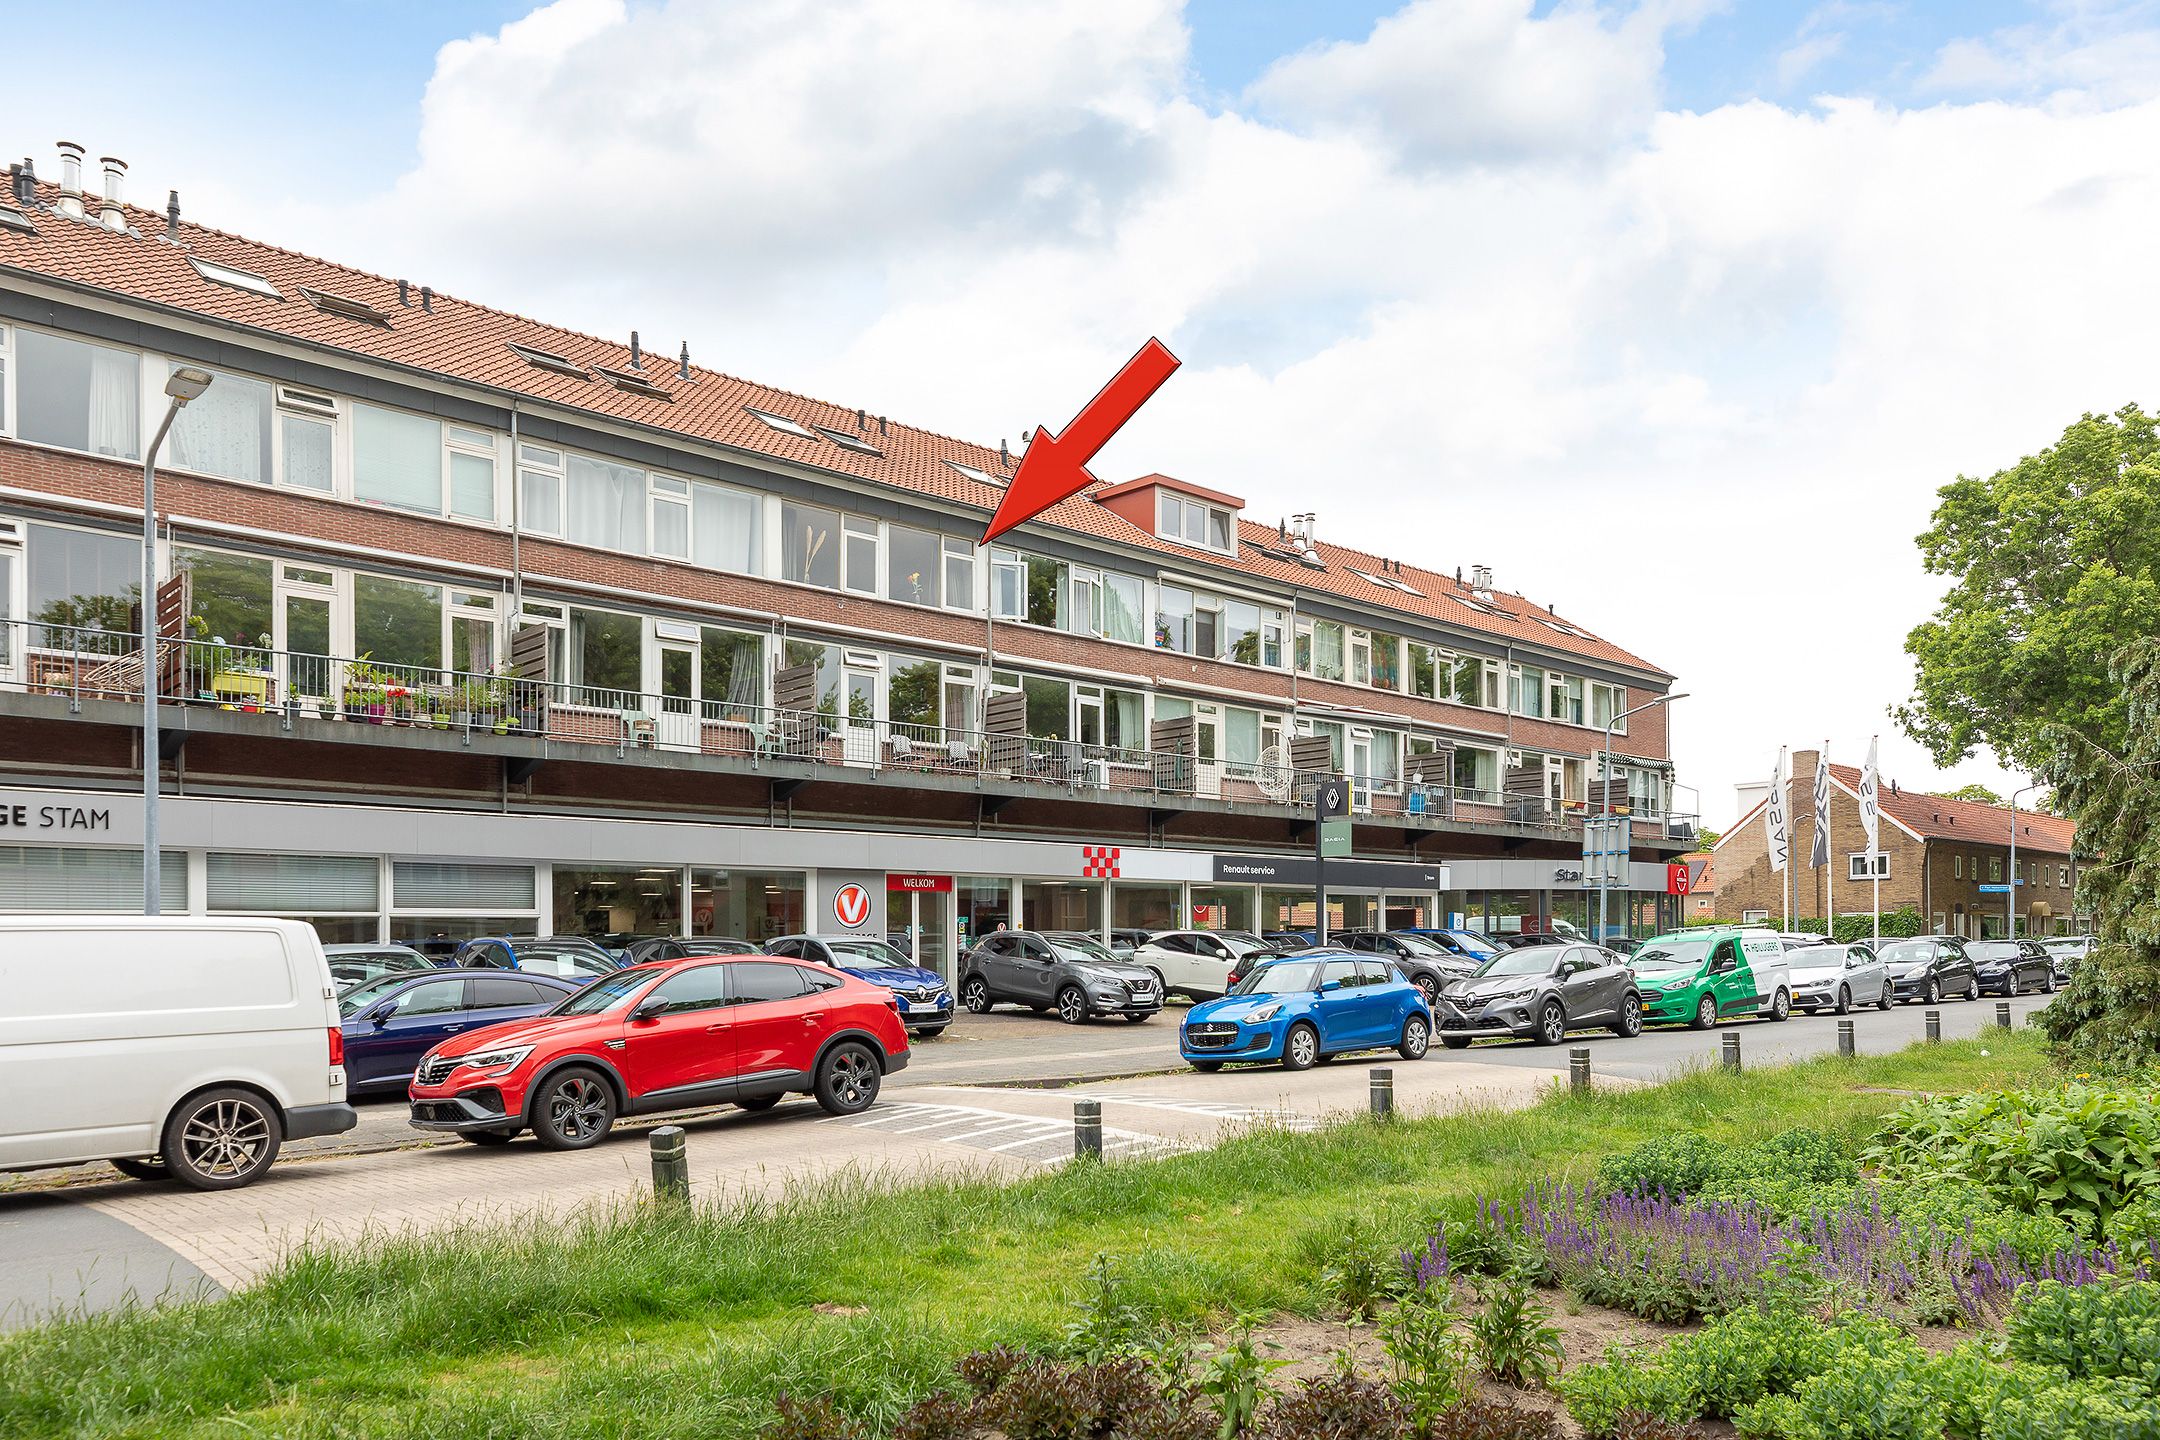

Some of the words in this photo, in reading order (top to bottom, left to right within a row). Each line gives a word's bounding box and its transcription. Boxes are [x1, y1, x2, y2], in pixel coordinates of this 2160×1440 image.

[39, 806, 109, 830] STAM
[1223, 864, 1250, 874] Renault
[1250, 866, 1275, 875] service
[903, 878, 935, 888] WELKOM
